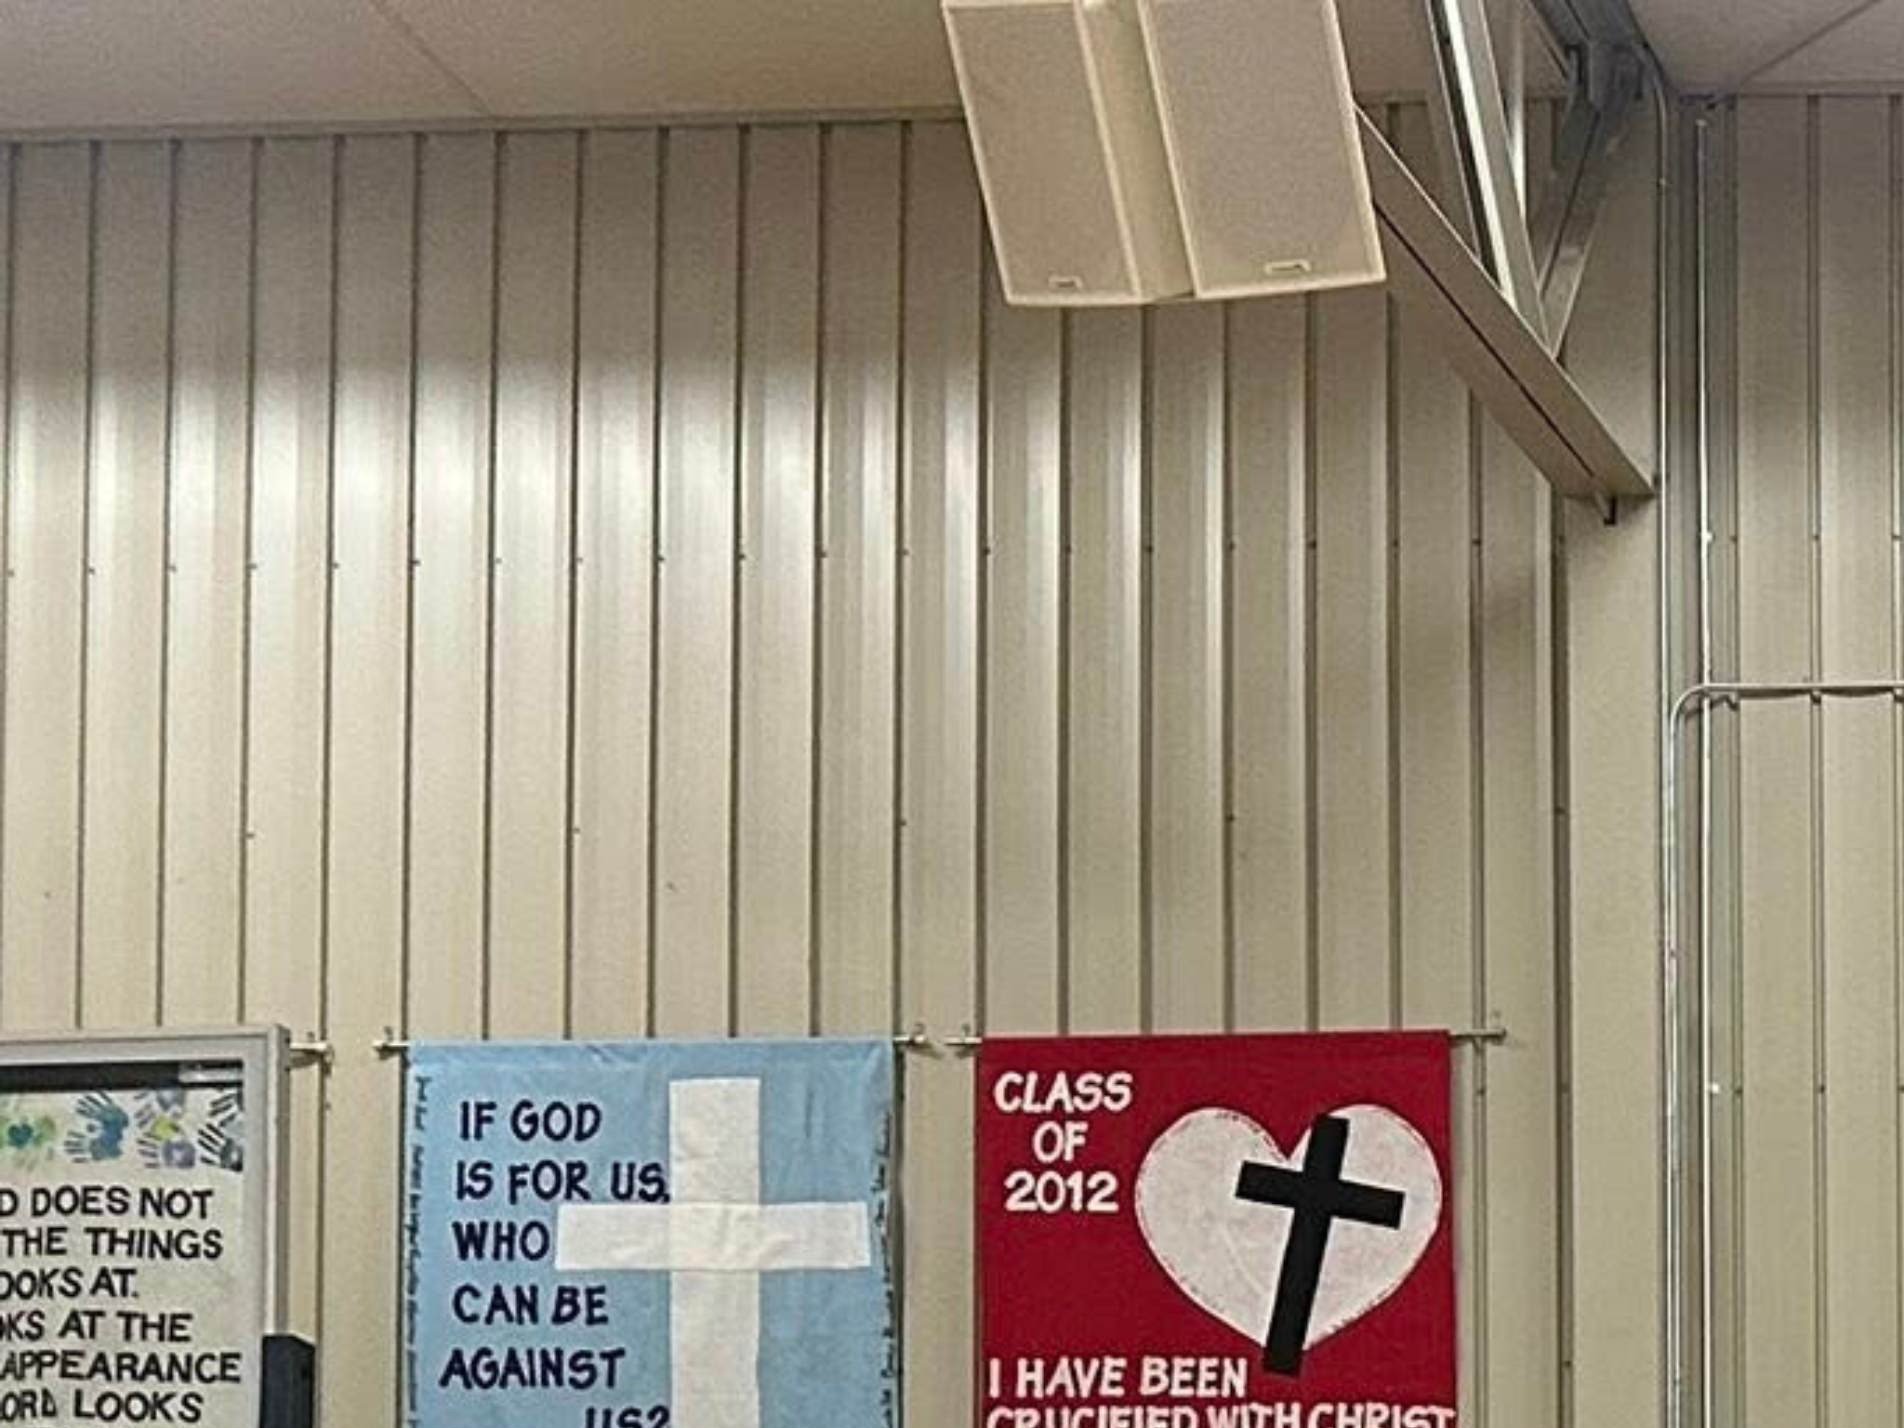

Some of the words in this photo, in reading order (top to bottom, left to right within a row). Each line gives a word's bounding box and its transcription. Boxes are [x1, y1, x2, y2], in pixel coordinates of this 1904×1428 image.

[994, 1072, 1133, 1112] CLASS
[460, 1101, 496, 1140] IF
[511, 1101, 600, 1141] GOD
[1033, 1123, 1088, 1162] OF
[457, 1162, 493, 1200] IS
[508, 1161, 590, 1203] FOR
[1004, 1172, 1119, 1213] 2012
[31, 1185, 130, 1217] DOES
[139, 1187, 214, 1219] NOT
[2, 1226, 68, 1257] THE
[84, 1227, 223, 1259] THINGS
[453, 1221, 550, 1260] WHO
[0, 1267, 83, 1300] OOKS
[90, 1266, 139, 1298] AT.
[453, 1286, 539, 1325] CAN
[553, 1285, 609, 1325] BE
[58, 1309, 105, 1339] AT
[116, 1311, 193, 1342] THE
[0, 1349, 241, 1383] APPEARANCE
[439, 1348, 625, 1389] AGAINST
[989, 1358, 1000, 1398] I
[1018, 1357, 1125, 1398] HAVE
[1139, 1357, 1247, 1398] BEEN
[0, 1387, 57, 1421] ORD
[74, 1389, 204, 1423] LOOKS
